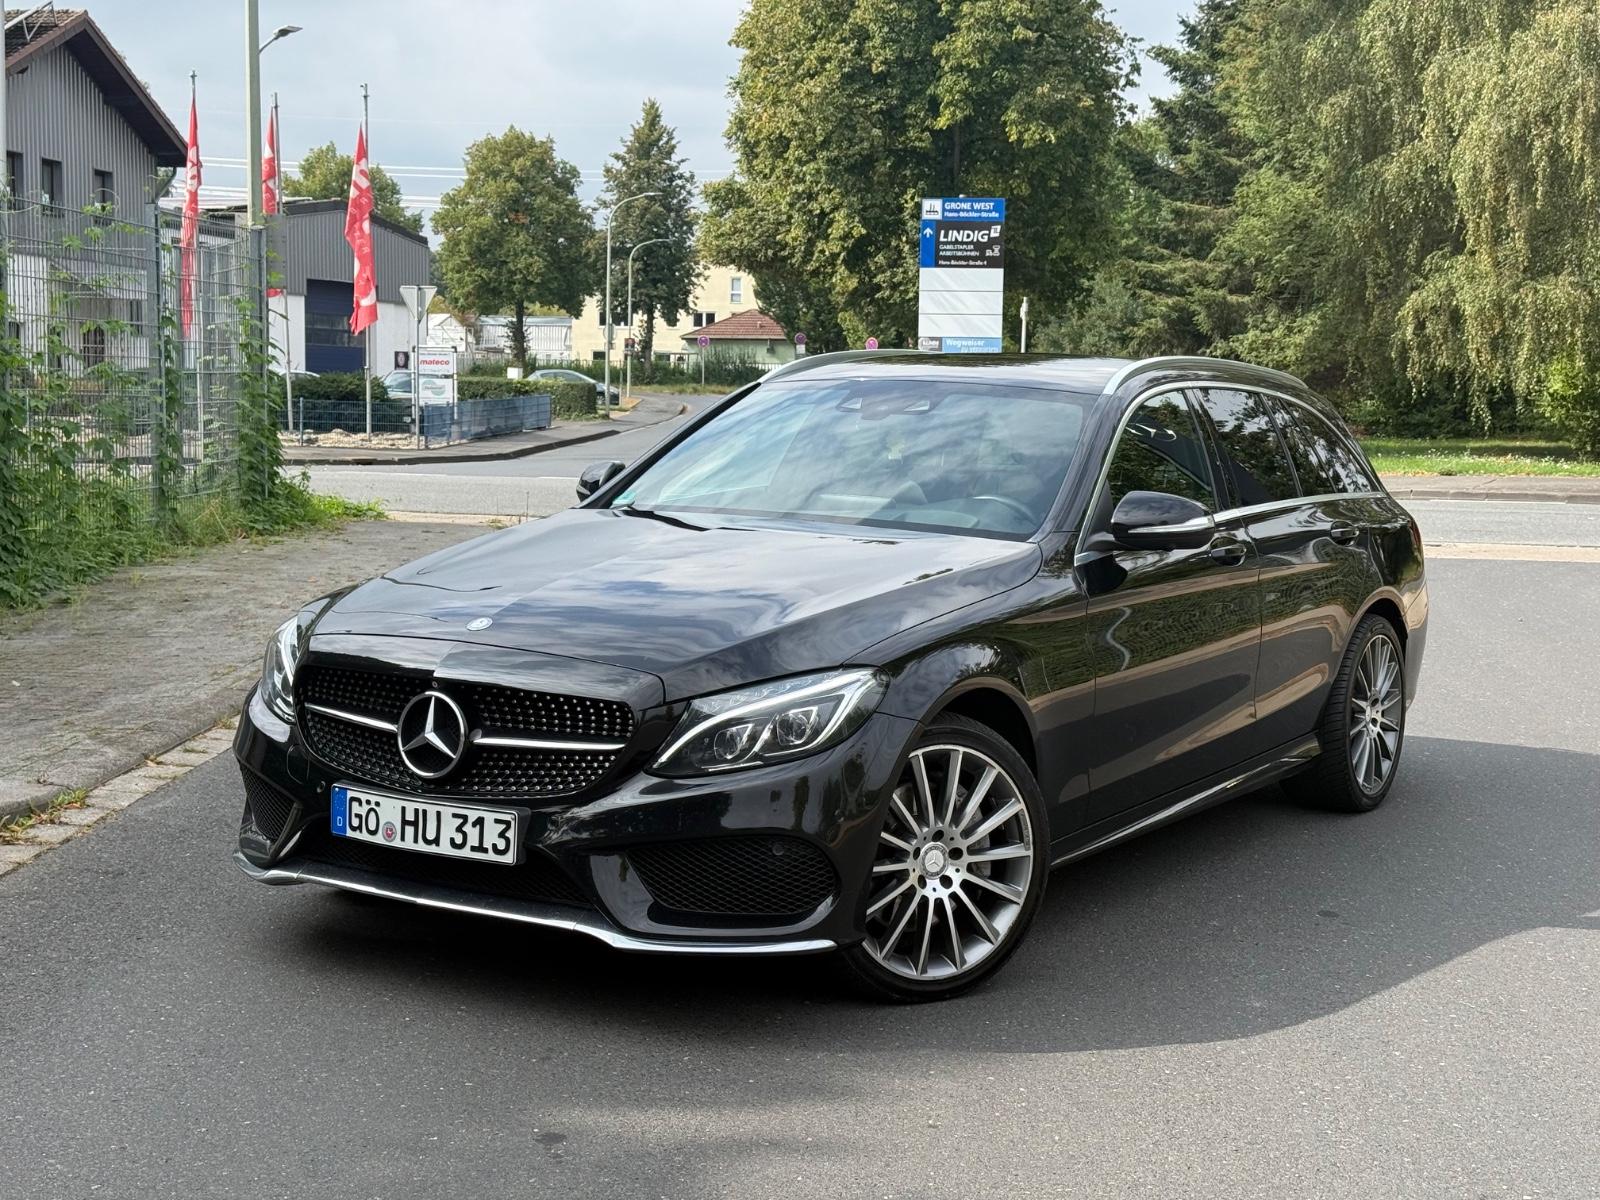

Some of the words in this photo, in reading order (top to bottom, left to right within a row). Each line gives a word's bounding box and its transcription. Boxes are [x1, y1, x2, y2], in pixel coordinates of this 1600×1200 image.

[944, 202, 971, 210] GRONE
[972, 202, 995, 210] WEST
[940, 230, 989, 242] LINDIG
[349, 796, 381, 836] GÖ
[400, 805, 442, 847] HU
[449, 812, 512, 857] 313
